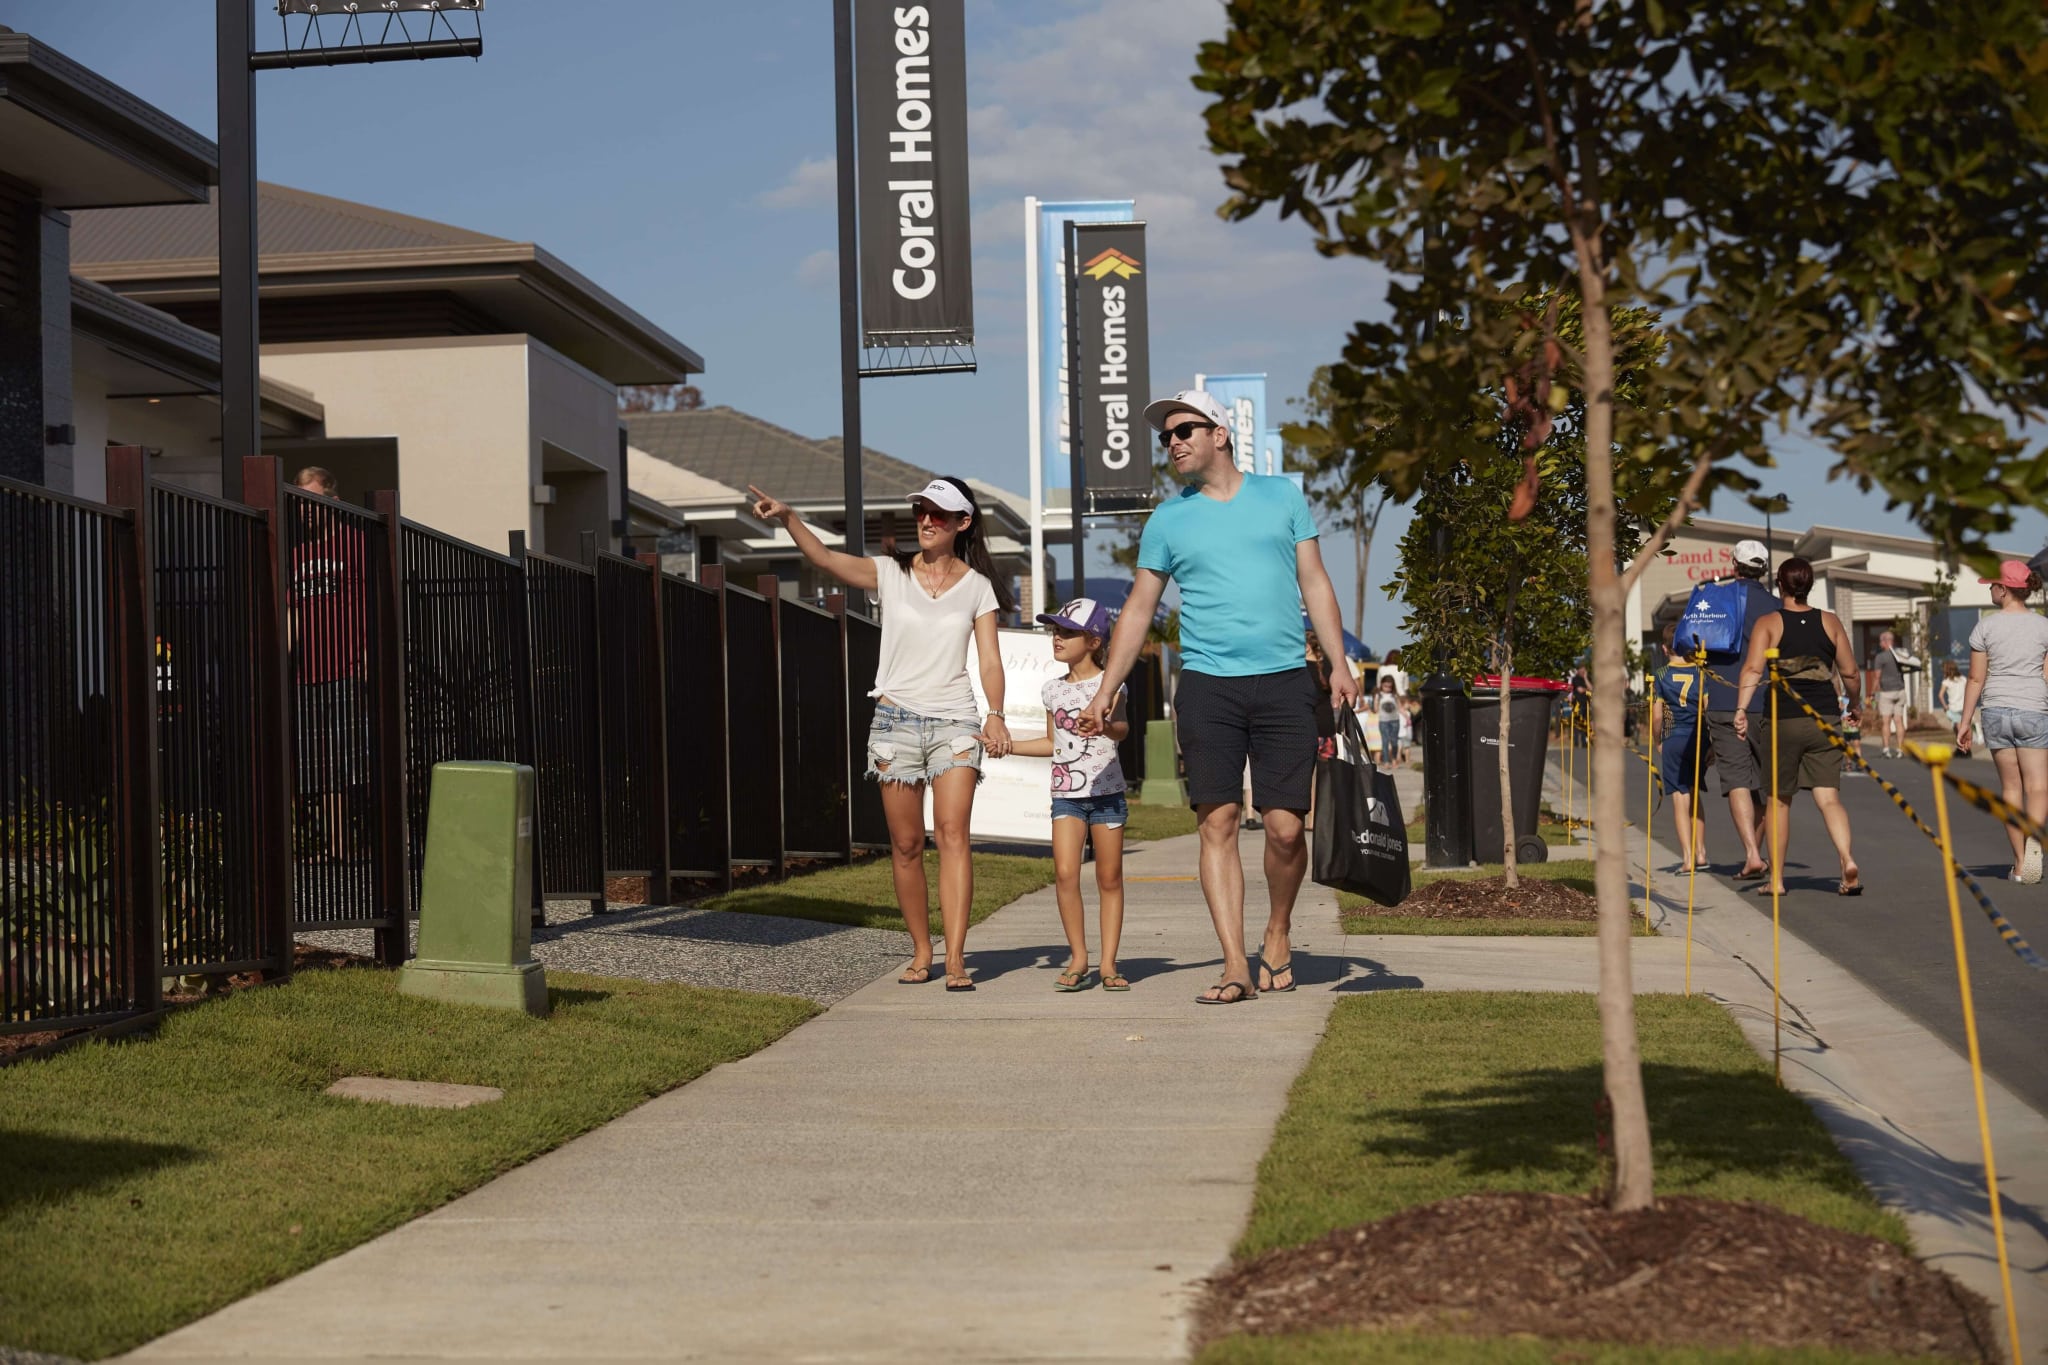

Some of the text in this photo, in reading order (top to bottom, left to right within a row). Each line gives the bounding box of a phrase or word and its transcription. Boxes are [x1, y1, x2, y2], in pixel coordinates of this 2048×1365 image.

[888, 5, 936, 300] Coral Homes
[1099, 285, 1130, 470] Coral Homes
[1236, 397, 1255, 474] omes
[1672, 674, 1694, 707] 7
